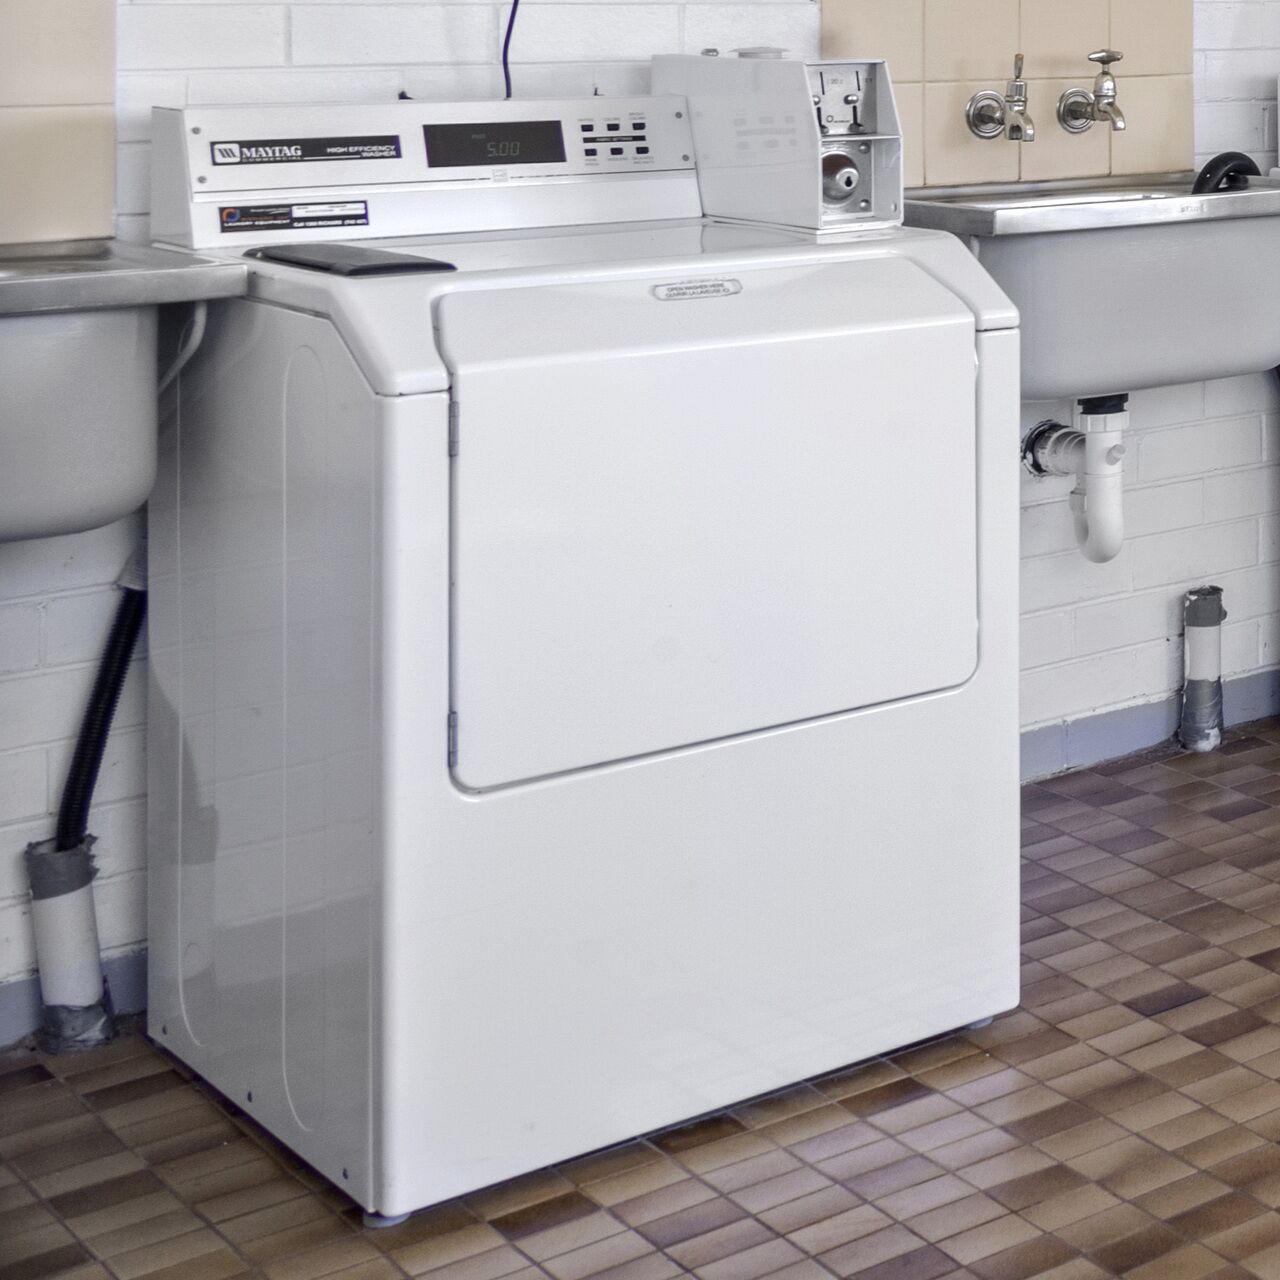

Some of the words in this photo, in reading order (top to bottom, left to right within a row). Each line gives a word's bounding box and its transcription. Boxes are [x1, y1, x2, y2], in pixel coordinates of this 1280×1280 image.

[241, 144, 303, 159] MAYTAG
[326, 146, 349, 154] HIGH
[349, 144, 397, 153] EFFICIENCY
[361, 150, 397, 158] WASHER
[487, 141, 520, 157] 5.00
